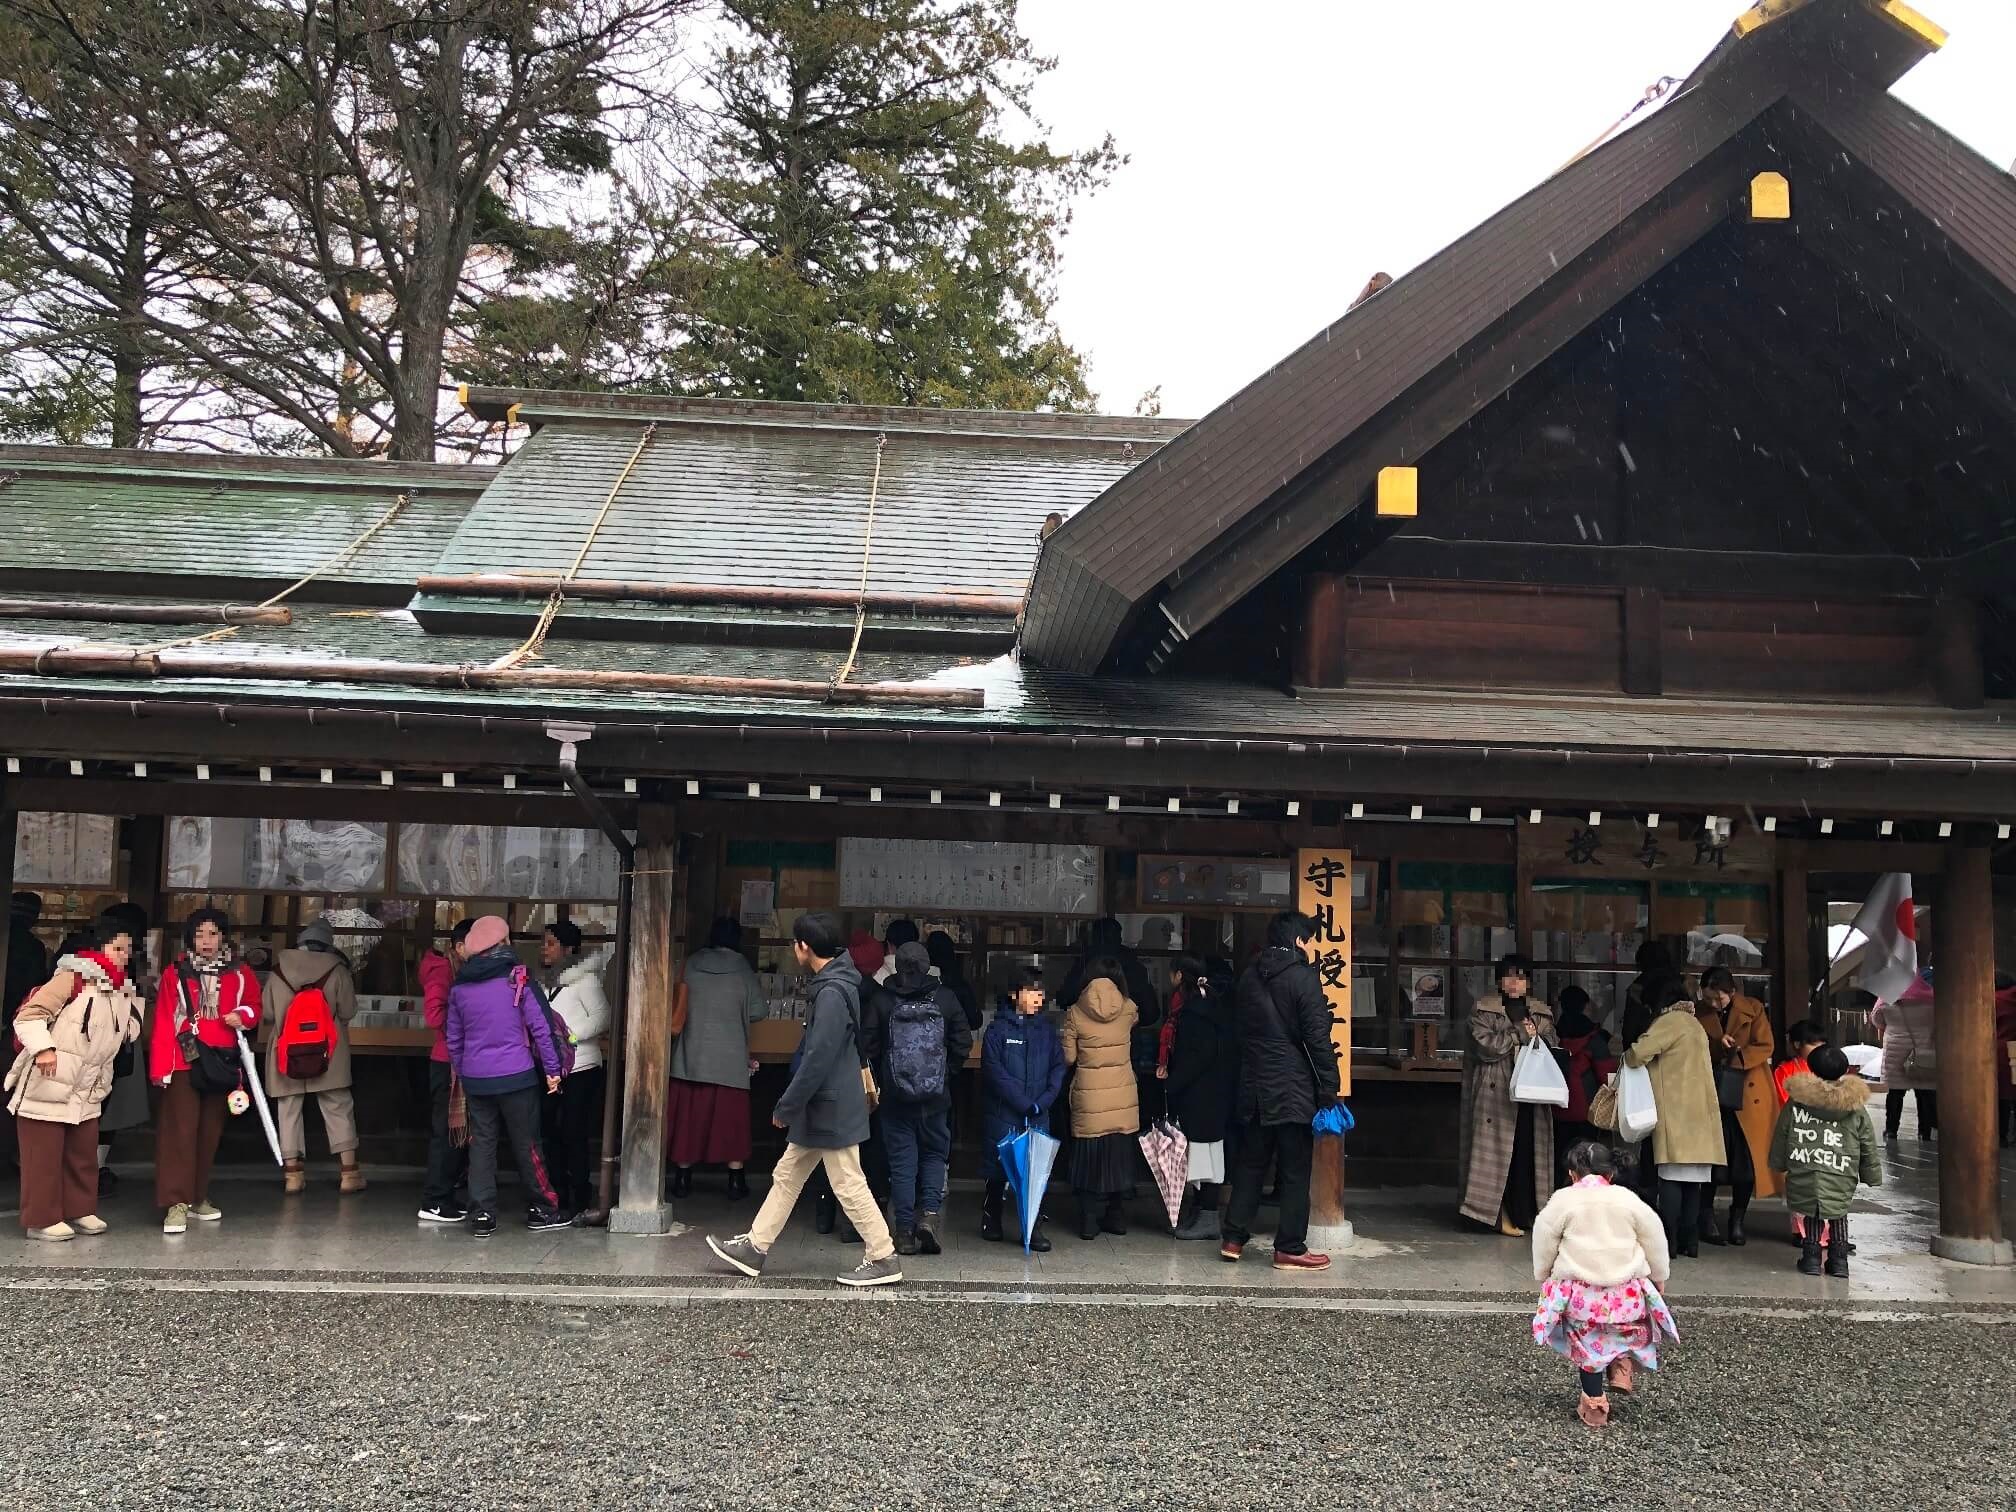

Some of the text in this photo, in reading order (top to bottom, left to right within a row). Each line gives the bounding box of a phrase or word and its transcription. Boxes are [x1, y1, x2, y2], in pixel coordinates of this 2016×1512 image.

[1304, 857, 1347, 1064] 守札授
[1794, 1127, 1844, 1148] TO BE
[1789, 1147, 1852, 1173] MYSELF
